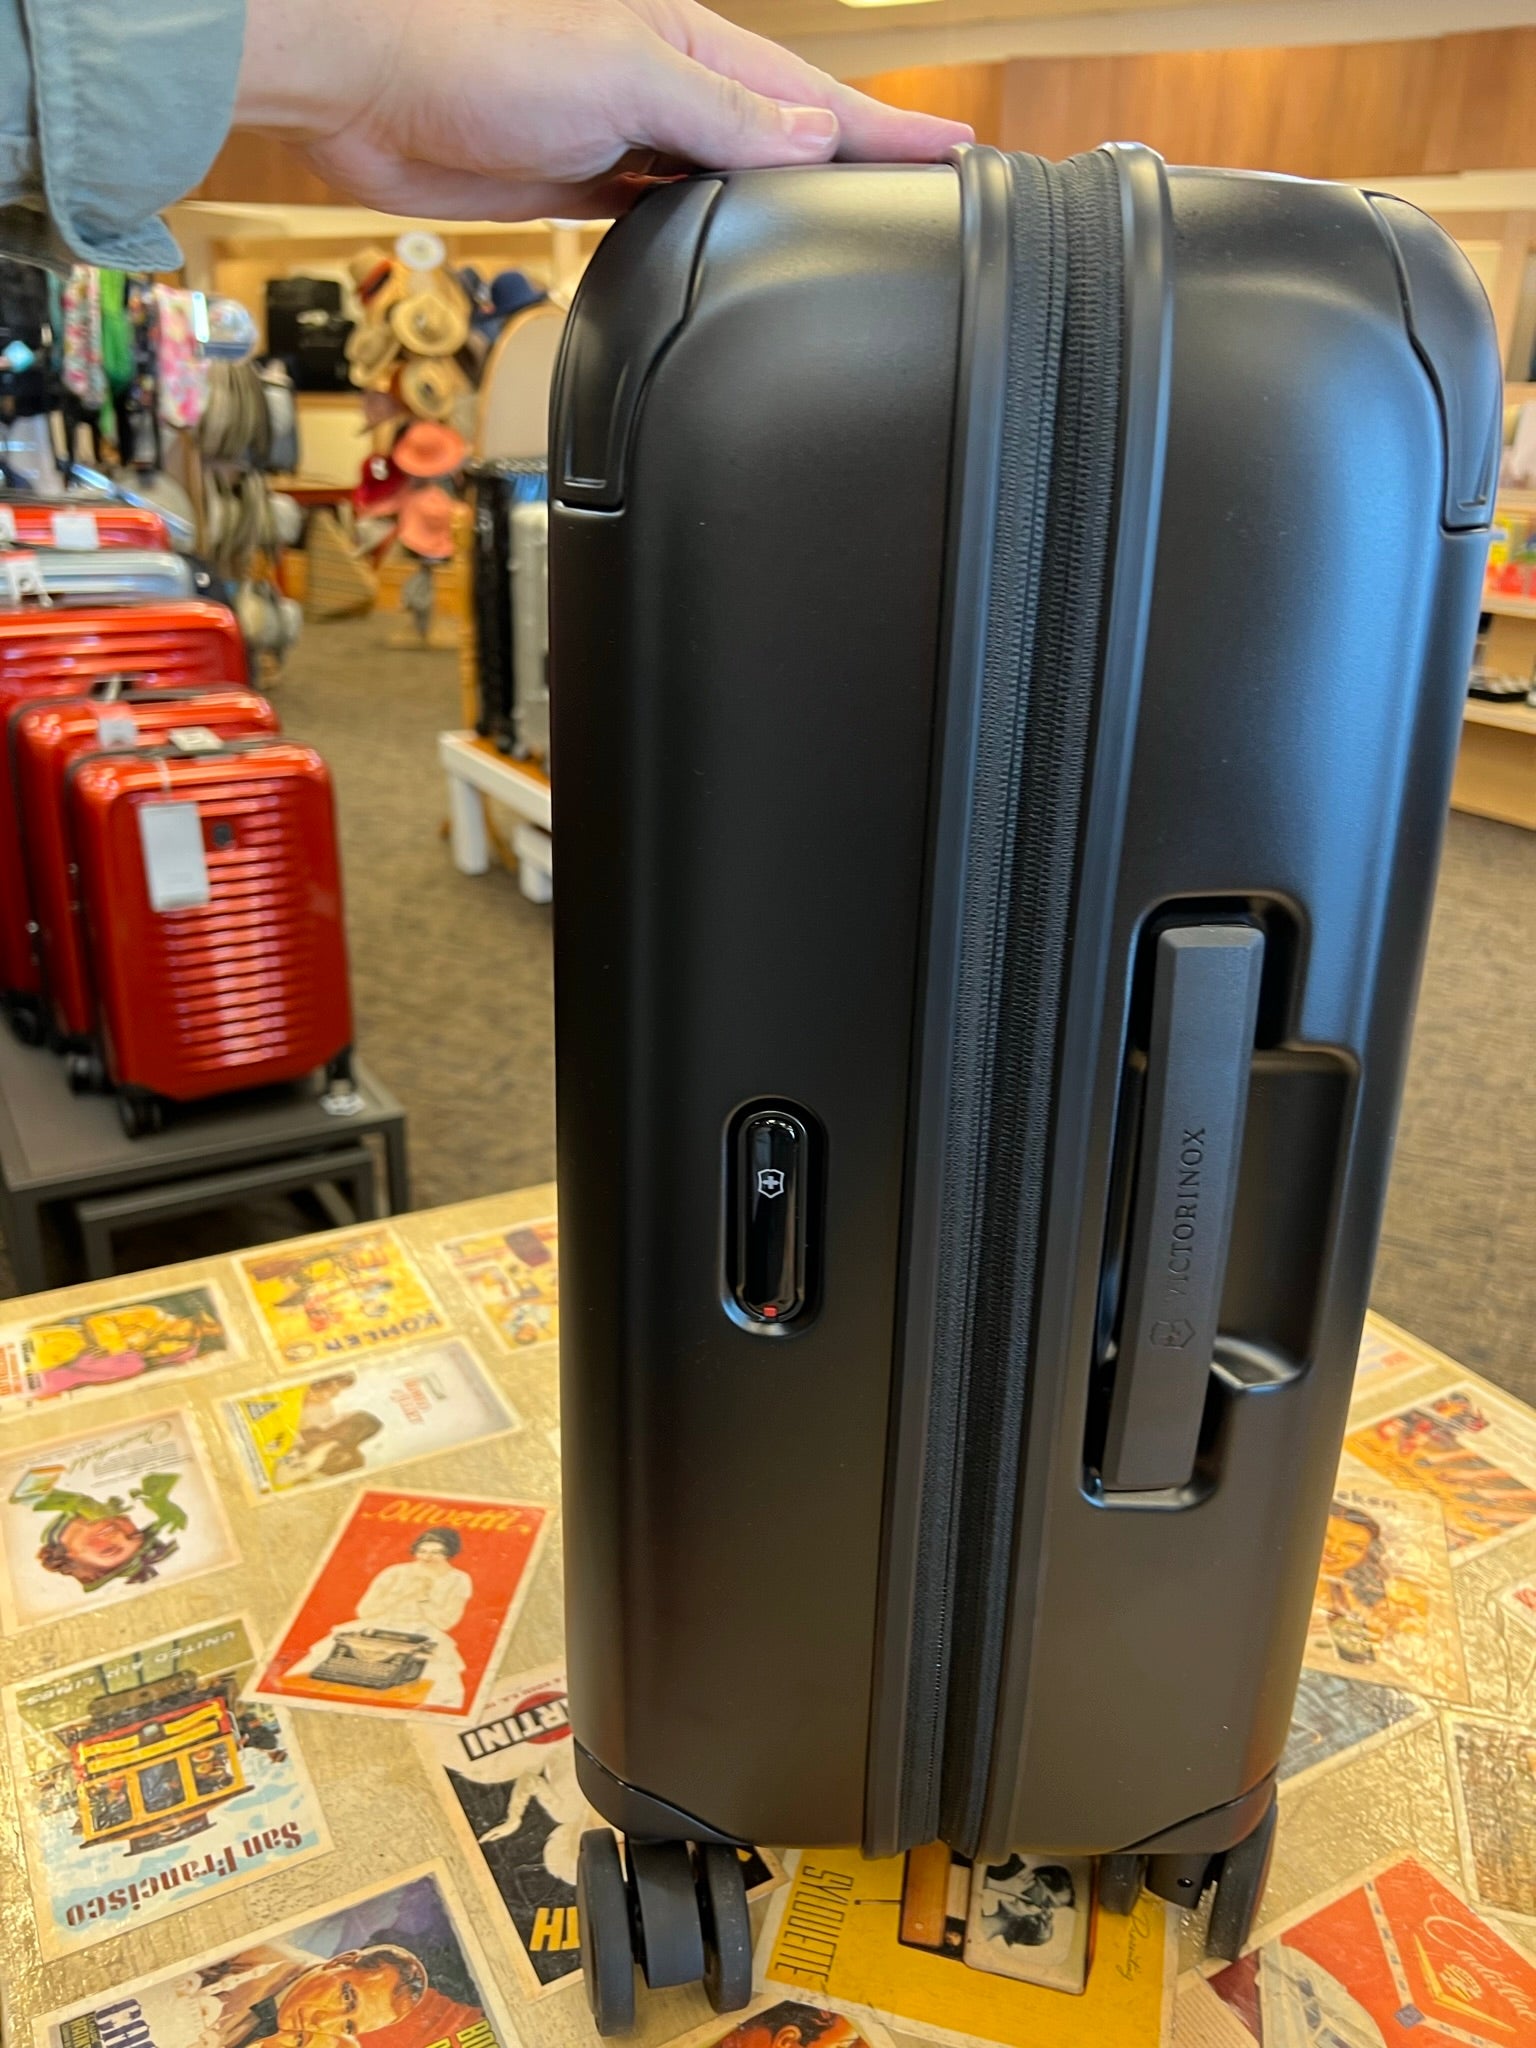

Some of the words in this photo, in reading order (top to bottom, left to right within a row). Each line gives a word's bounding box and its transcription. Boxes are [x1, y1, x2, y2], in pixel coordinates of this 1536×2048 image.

[1166, 1127, 1206, 1298] VICTORINOX
[324, 1311, 441, 1354] KOHLER
[374, 1499, 527, 1533] Olivetti
[154, 1630, 236, 1664] UNITED
[104, 1658, 145, 1680] AIR
[243, 1821, 302, 1858] San
[65, 1846, 239, 1927] Francisco
